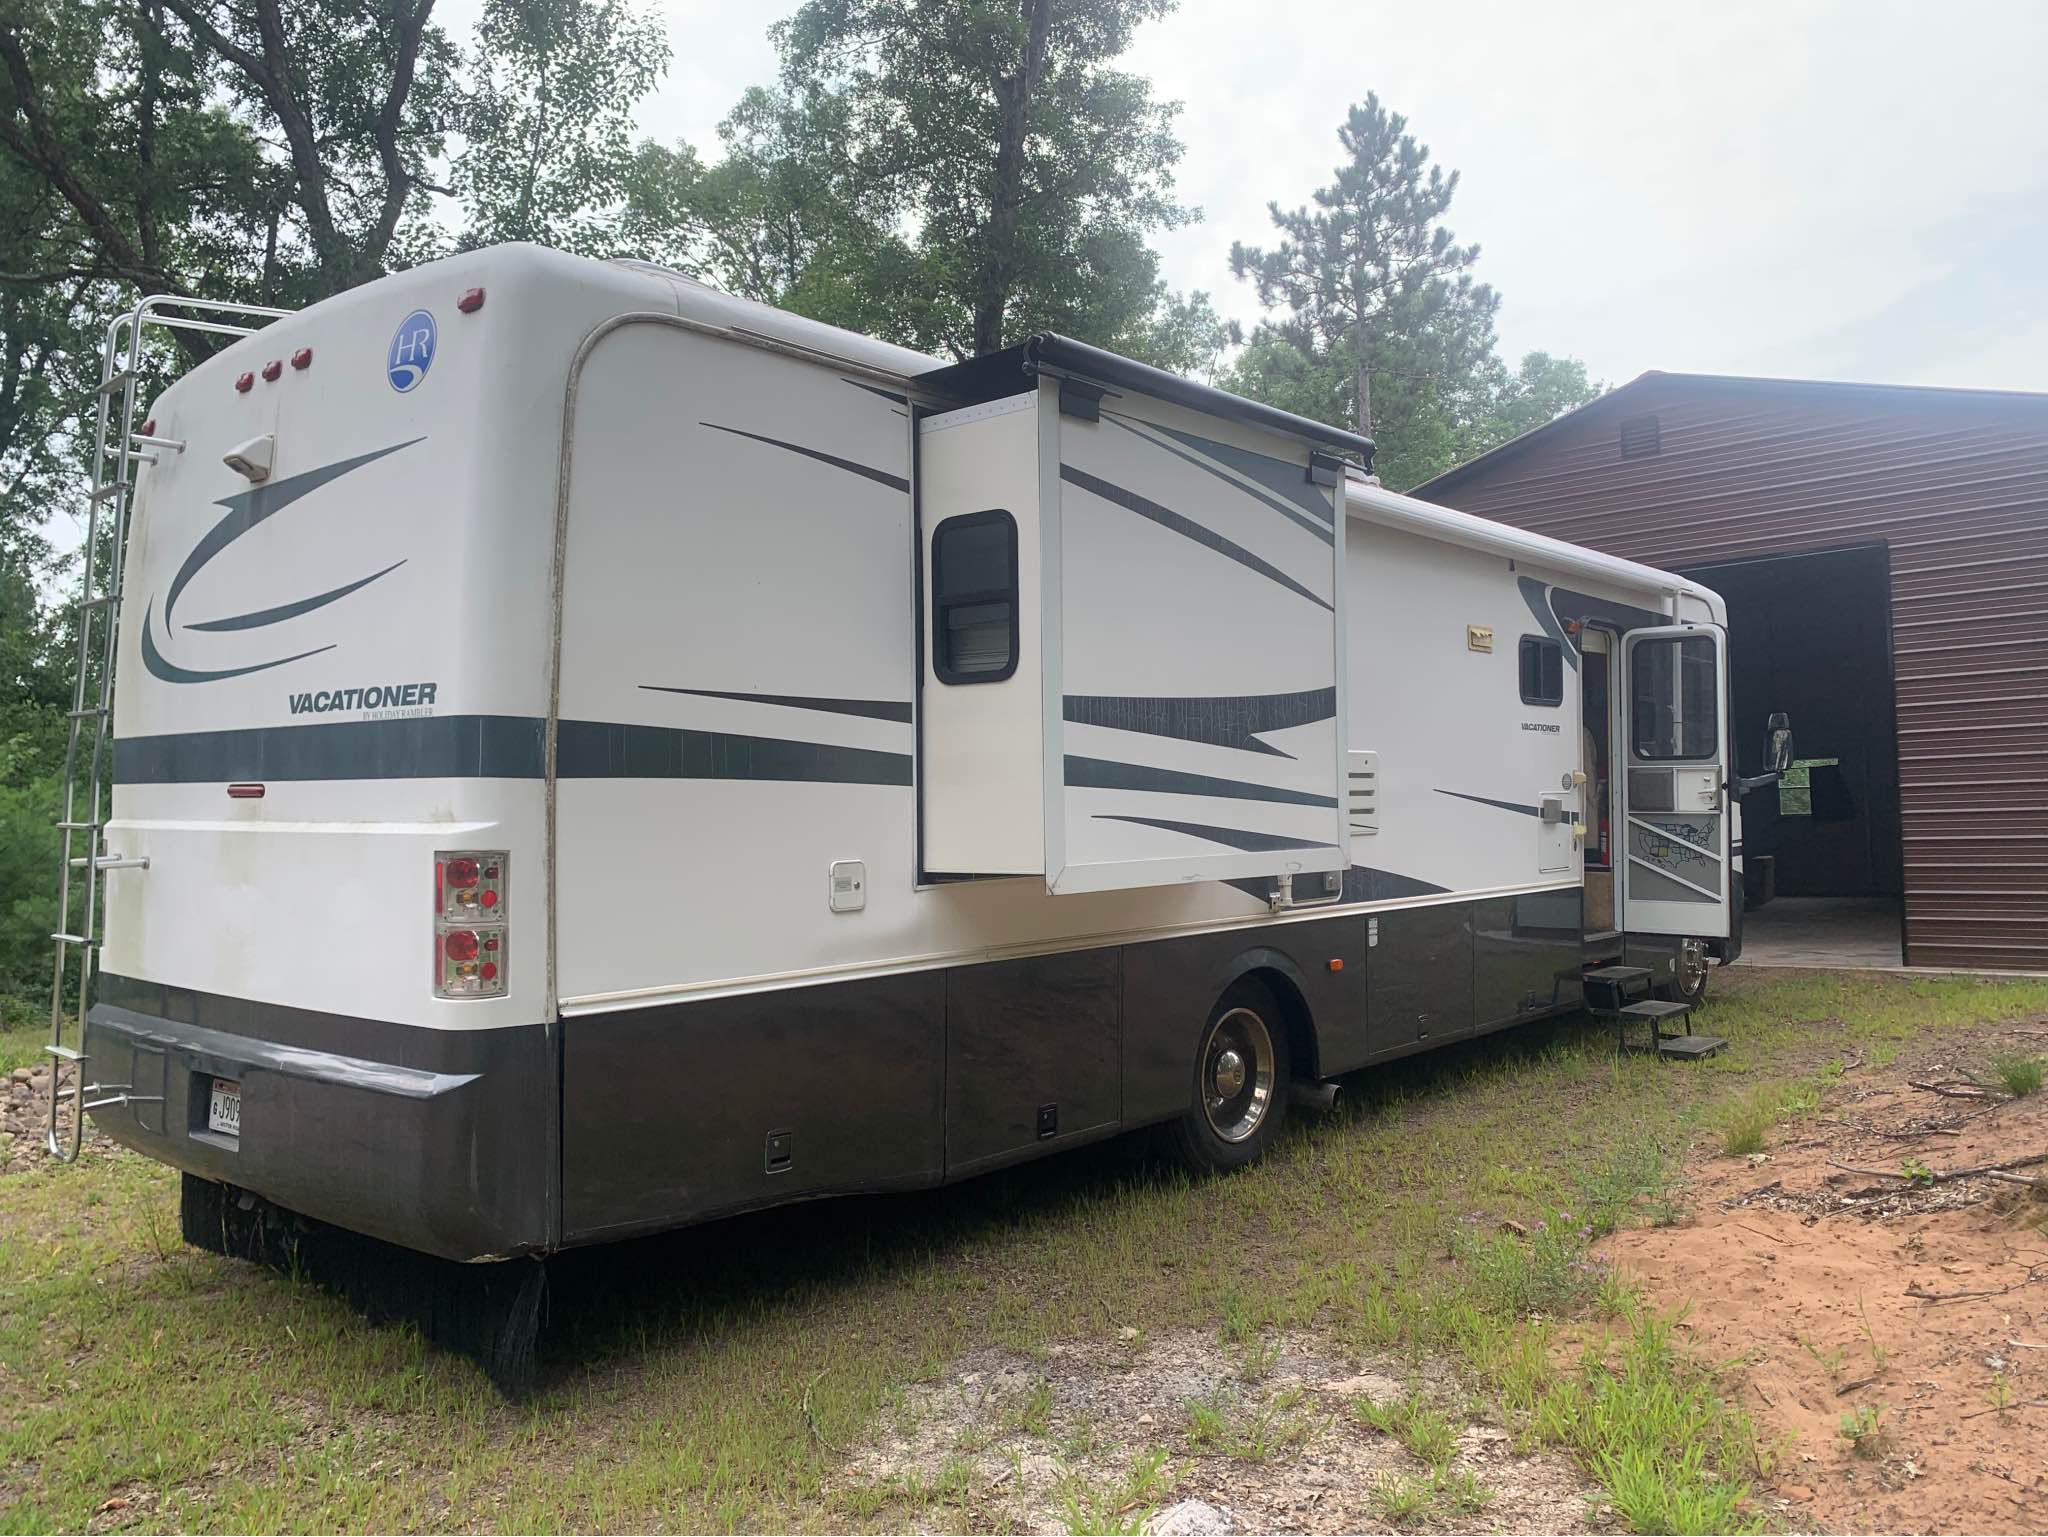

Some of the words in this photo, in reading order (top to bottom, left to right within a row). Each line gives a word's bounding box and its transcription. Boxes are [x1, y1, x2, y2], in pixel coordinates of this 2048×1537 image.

[395, 328, 430, 365] HR
[289, 682, 438, 714] VACATIONER
[401, 707, 433, 720] RAMBLER
[1521, 723, 1560, 733] VACATIONER
